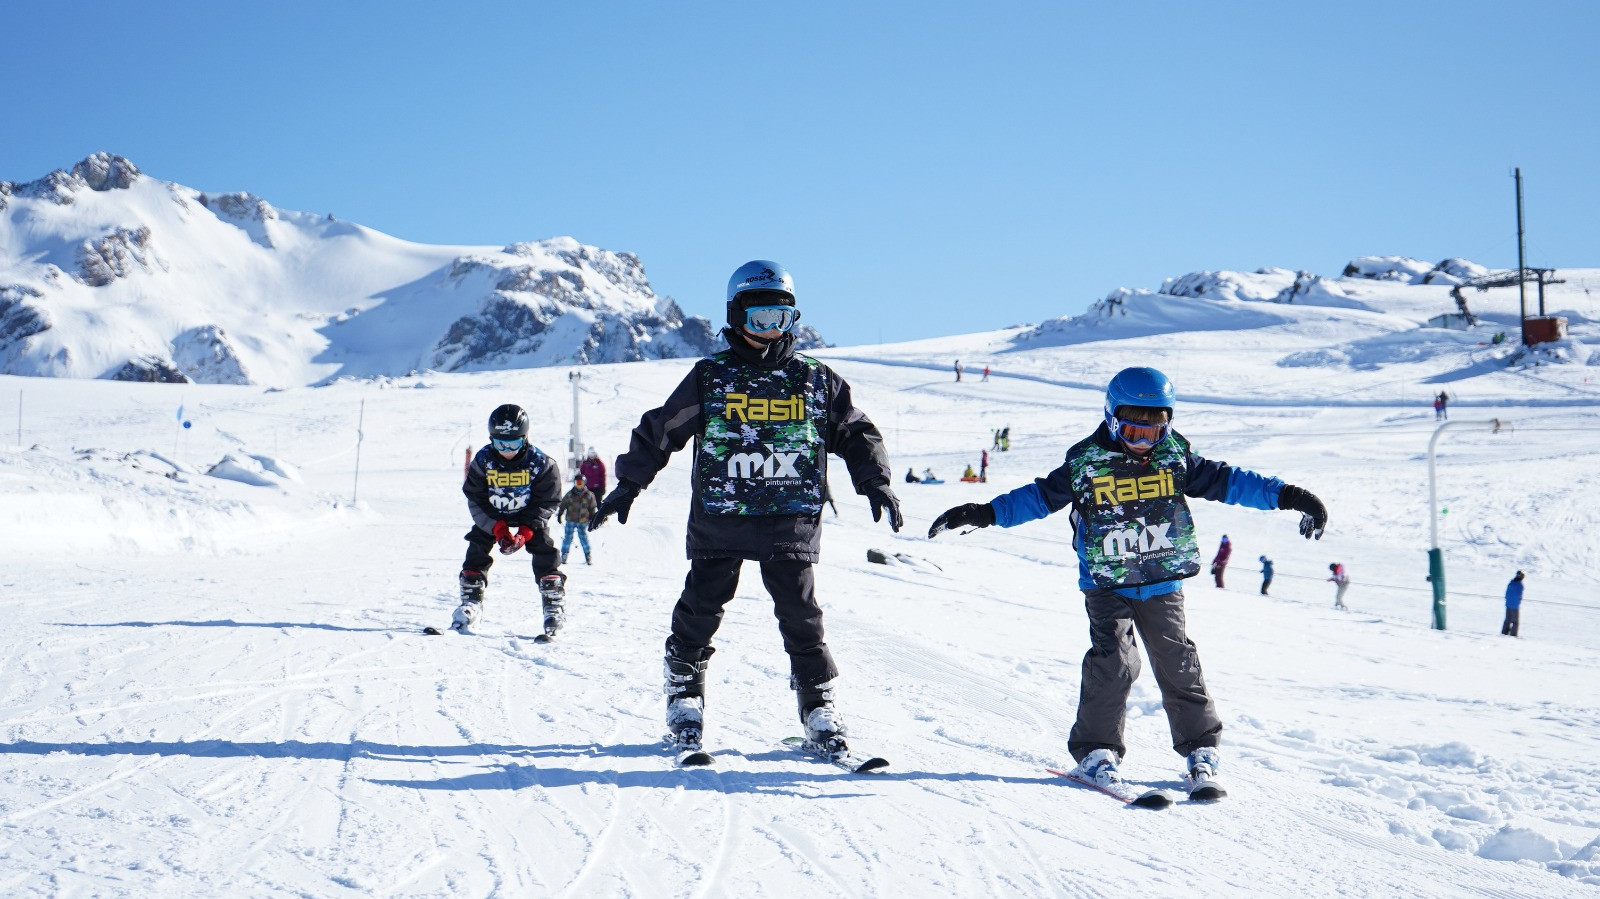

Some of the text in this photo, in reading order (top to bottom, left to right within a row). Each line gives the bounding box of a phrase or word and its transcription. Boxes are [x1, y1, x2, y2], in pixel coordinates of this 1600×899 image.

[725, 393, 804, 423] Rasti
[728, 443, 800, 478] mix
[487, 469, 530, 488] Rasti
[1092, 468, 1174, 506] Rasti
[489, 492, 527, 510] mix
[1103, 516, 1175, 556] mix
